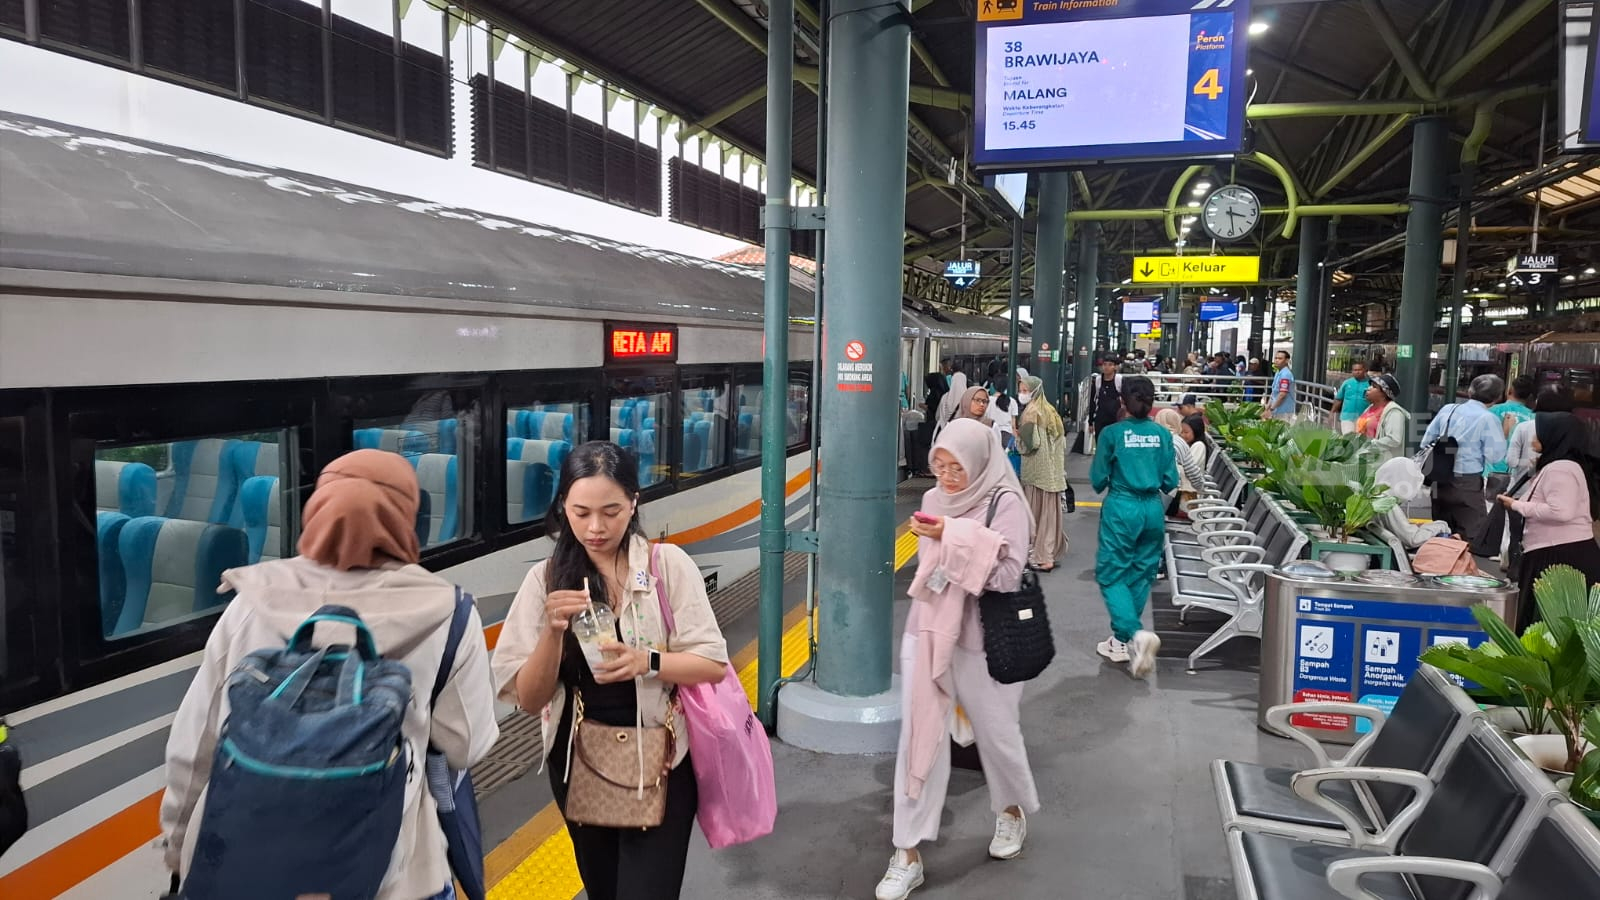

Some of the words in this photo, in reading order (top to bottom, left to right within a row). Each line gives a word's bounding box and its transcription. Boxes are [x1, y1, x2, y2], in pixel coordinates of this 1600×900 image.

[1033, 1, 1057, 11] Train
[1060, 0, 1118, 11] Information
[1004, 41, 1023, 53] 38
[1004, 50, 1100, 68] BRAWIJAYA
[1193, 68, 1223, 100] 4
[1003, 87, 1068, 101] MALANG
[1003, 119, 1036, 131] 15.45
[1522, 255, 1555, 265] JALUR
[947, 261, 973, 271] JALUR
[1183, 261, 1226, 272] Keluar
[955, 277, 965, 286] 4
[1528, 273, 1541, 285] 3
[1300, 659, 1330, 669] Sampah
[1364, 664, 1396, 675] Sampah
[1300, 672, 1329, 681] Dangerous
[1329, 675, 1347, 683] Waste
[1364, 671, 1404, 681] Anorganik
[1363, 679, 1391, 688] Inorganic
